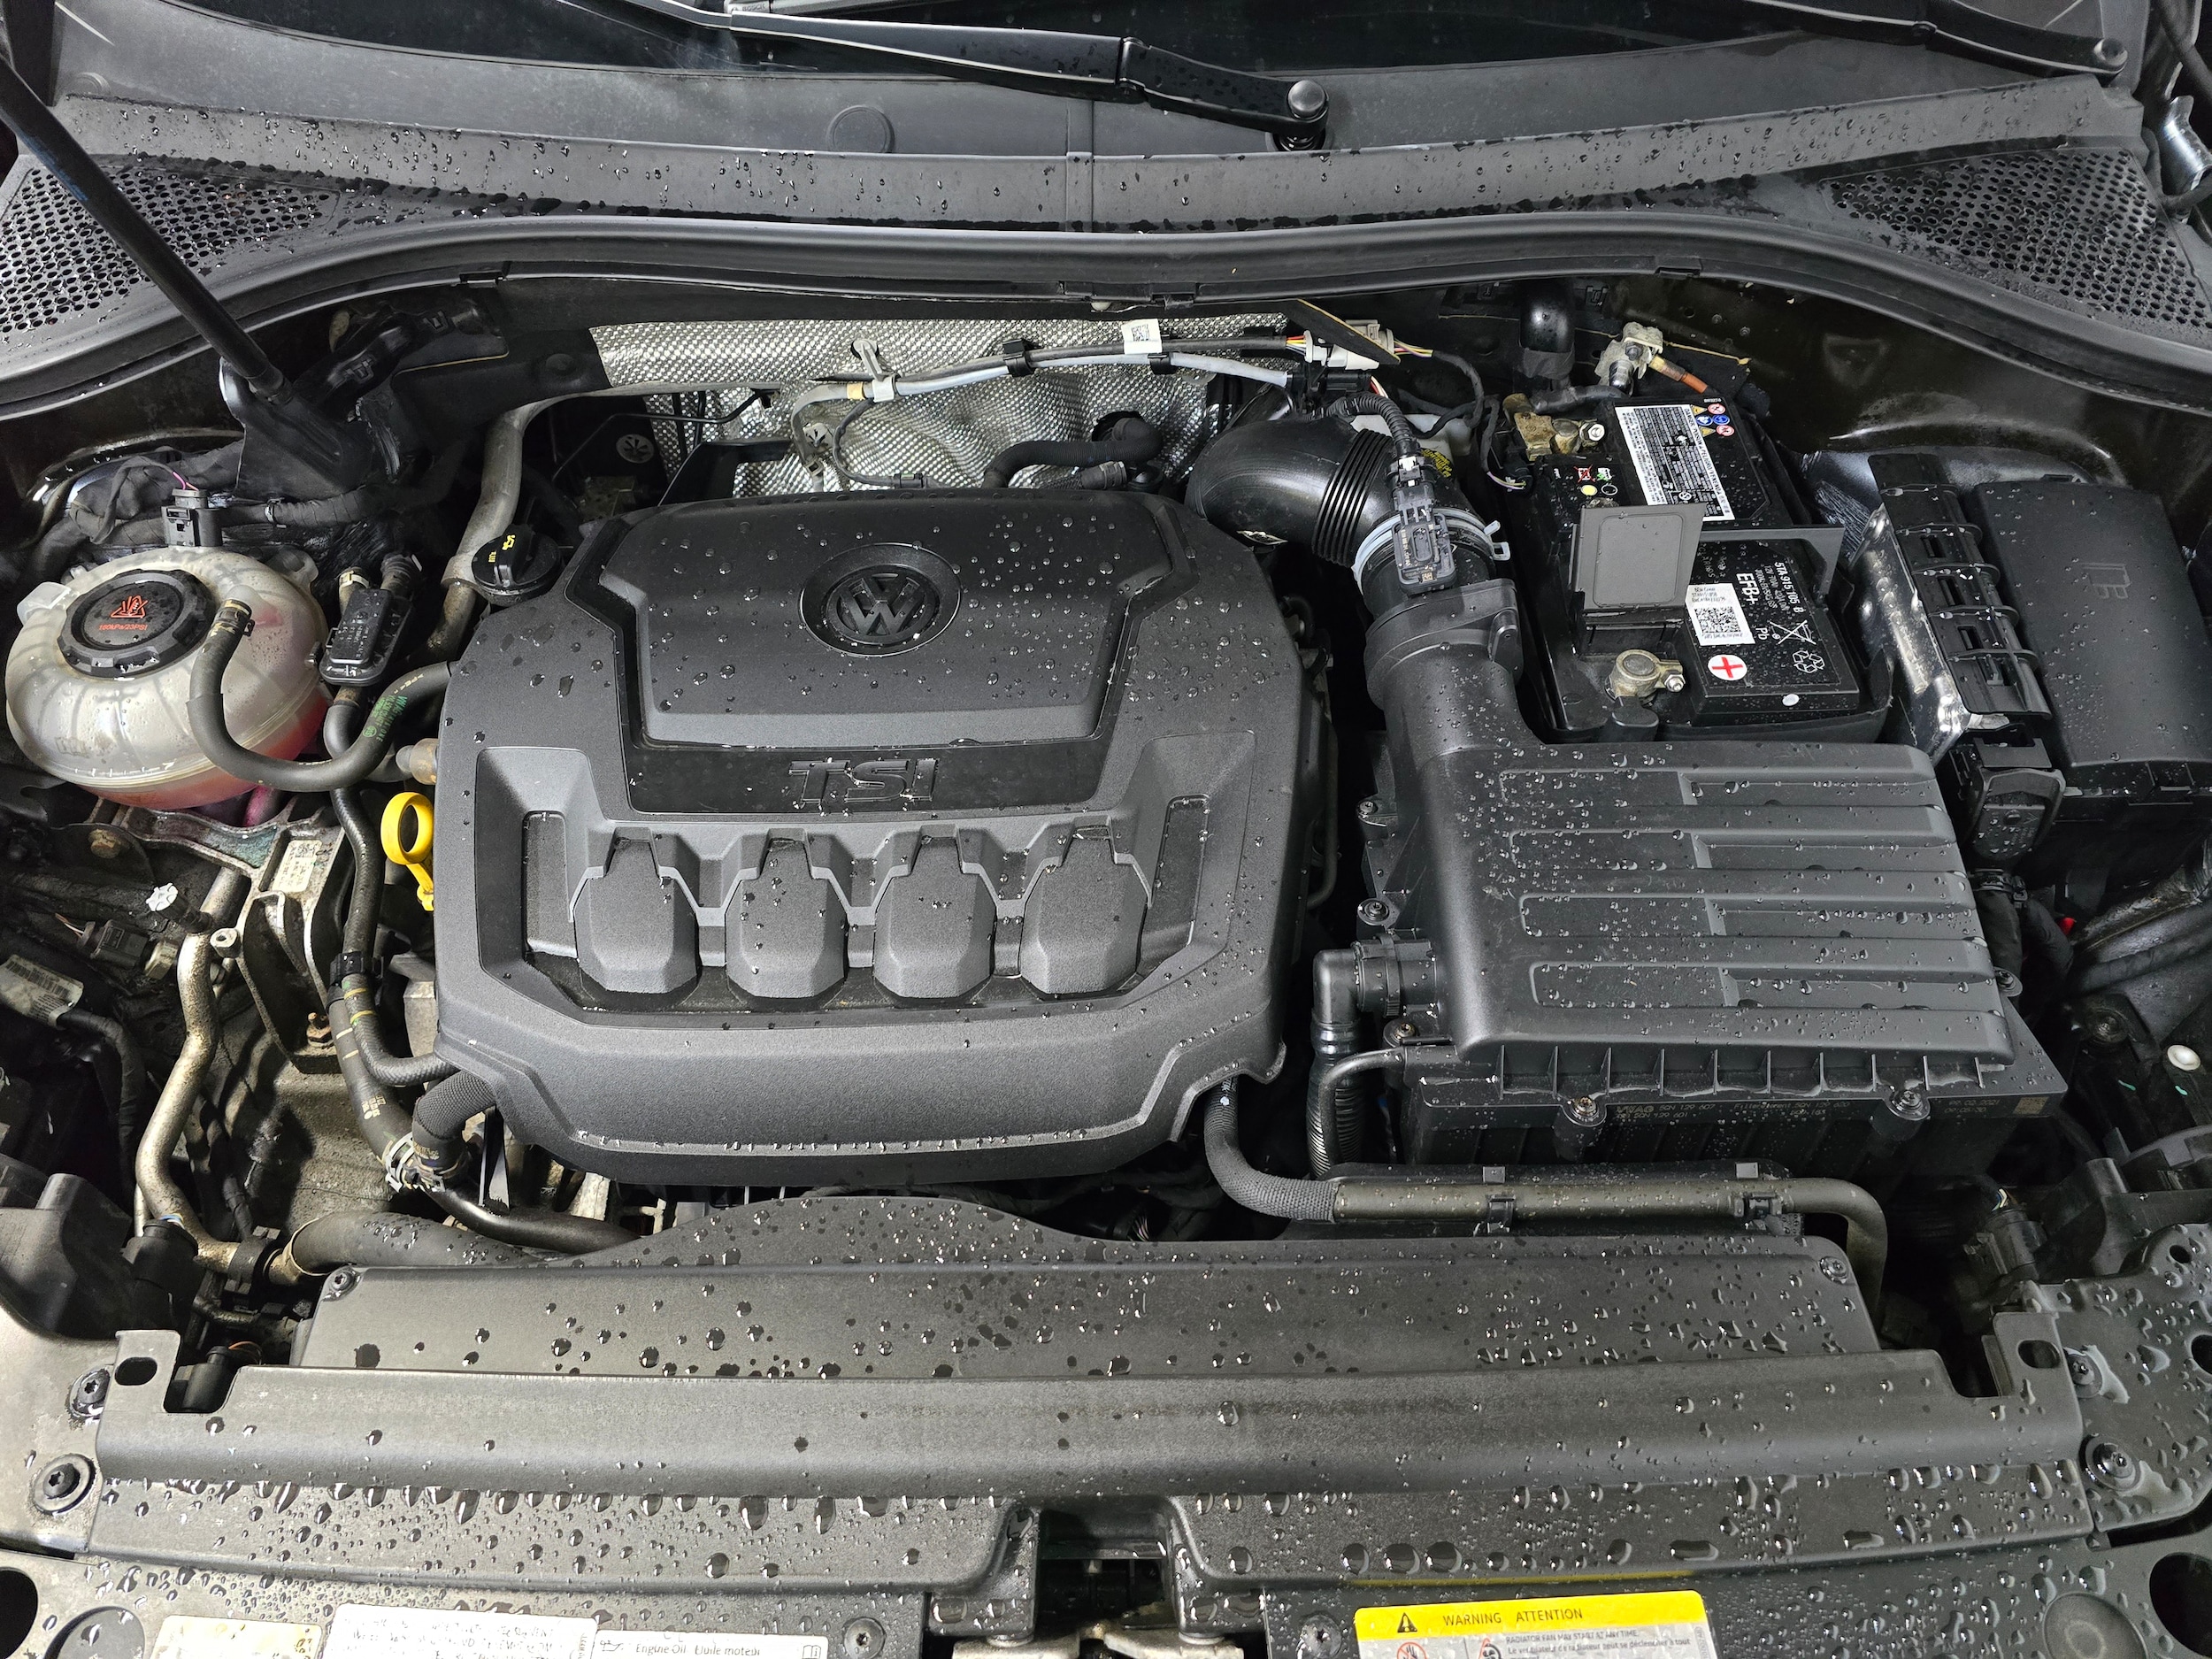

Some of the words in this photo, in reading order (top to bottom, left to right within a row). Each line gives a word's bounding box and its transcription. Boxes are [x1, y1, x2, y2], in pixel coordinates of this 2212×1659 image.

[1774, 561, 1788, 577] 5TA
[1736, 572, 1761, 604] EFB+
[1780, 575, 1794, 592] 915
[1786, 589, 1801, 604] 105
[1793, 605, 1806, 614] B
[1755, 626, 1770, 641] Pb
[788, 757, 941, 803] TSI
[1443, 1611, 1502, 1626] WARNING
[1516, 1608, 1584, 1623] ATTENTION
[1506, 1635, 1540, 1644] RADIATOR
[1602, 1641, 1619, 1651] peut
[636, 1643, 670, 1656] Engine
[672, 1643, 687, 1654] Oil
